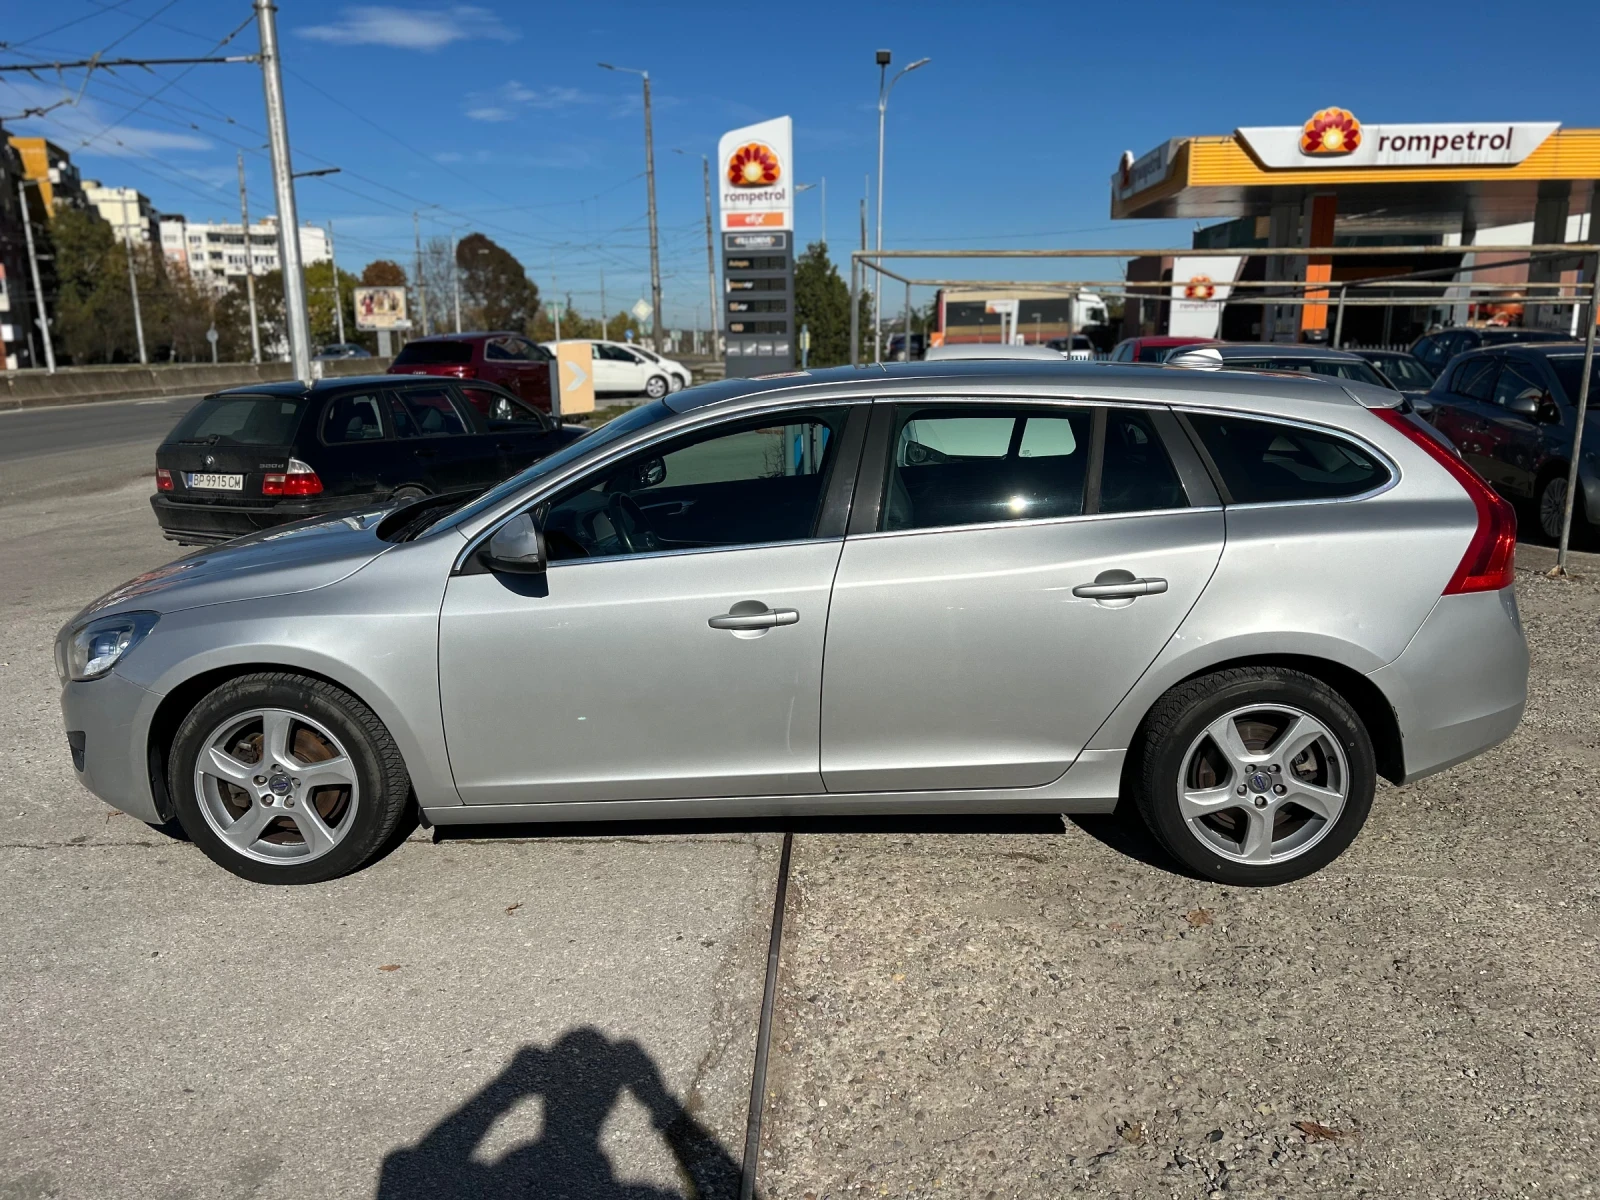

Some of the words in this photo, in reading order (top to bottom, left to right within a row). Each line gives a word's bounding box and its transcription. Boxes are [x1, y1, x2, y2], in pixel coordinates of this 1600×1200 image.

[1378, 126, 1514, 159] rompetrol
[724, 188, 786, 205] rompetrol
[206, 474, 227, 488] 9915
